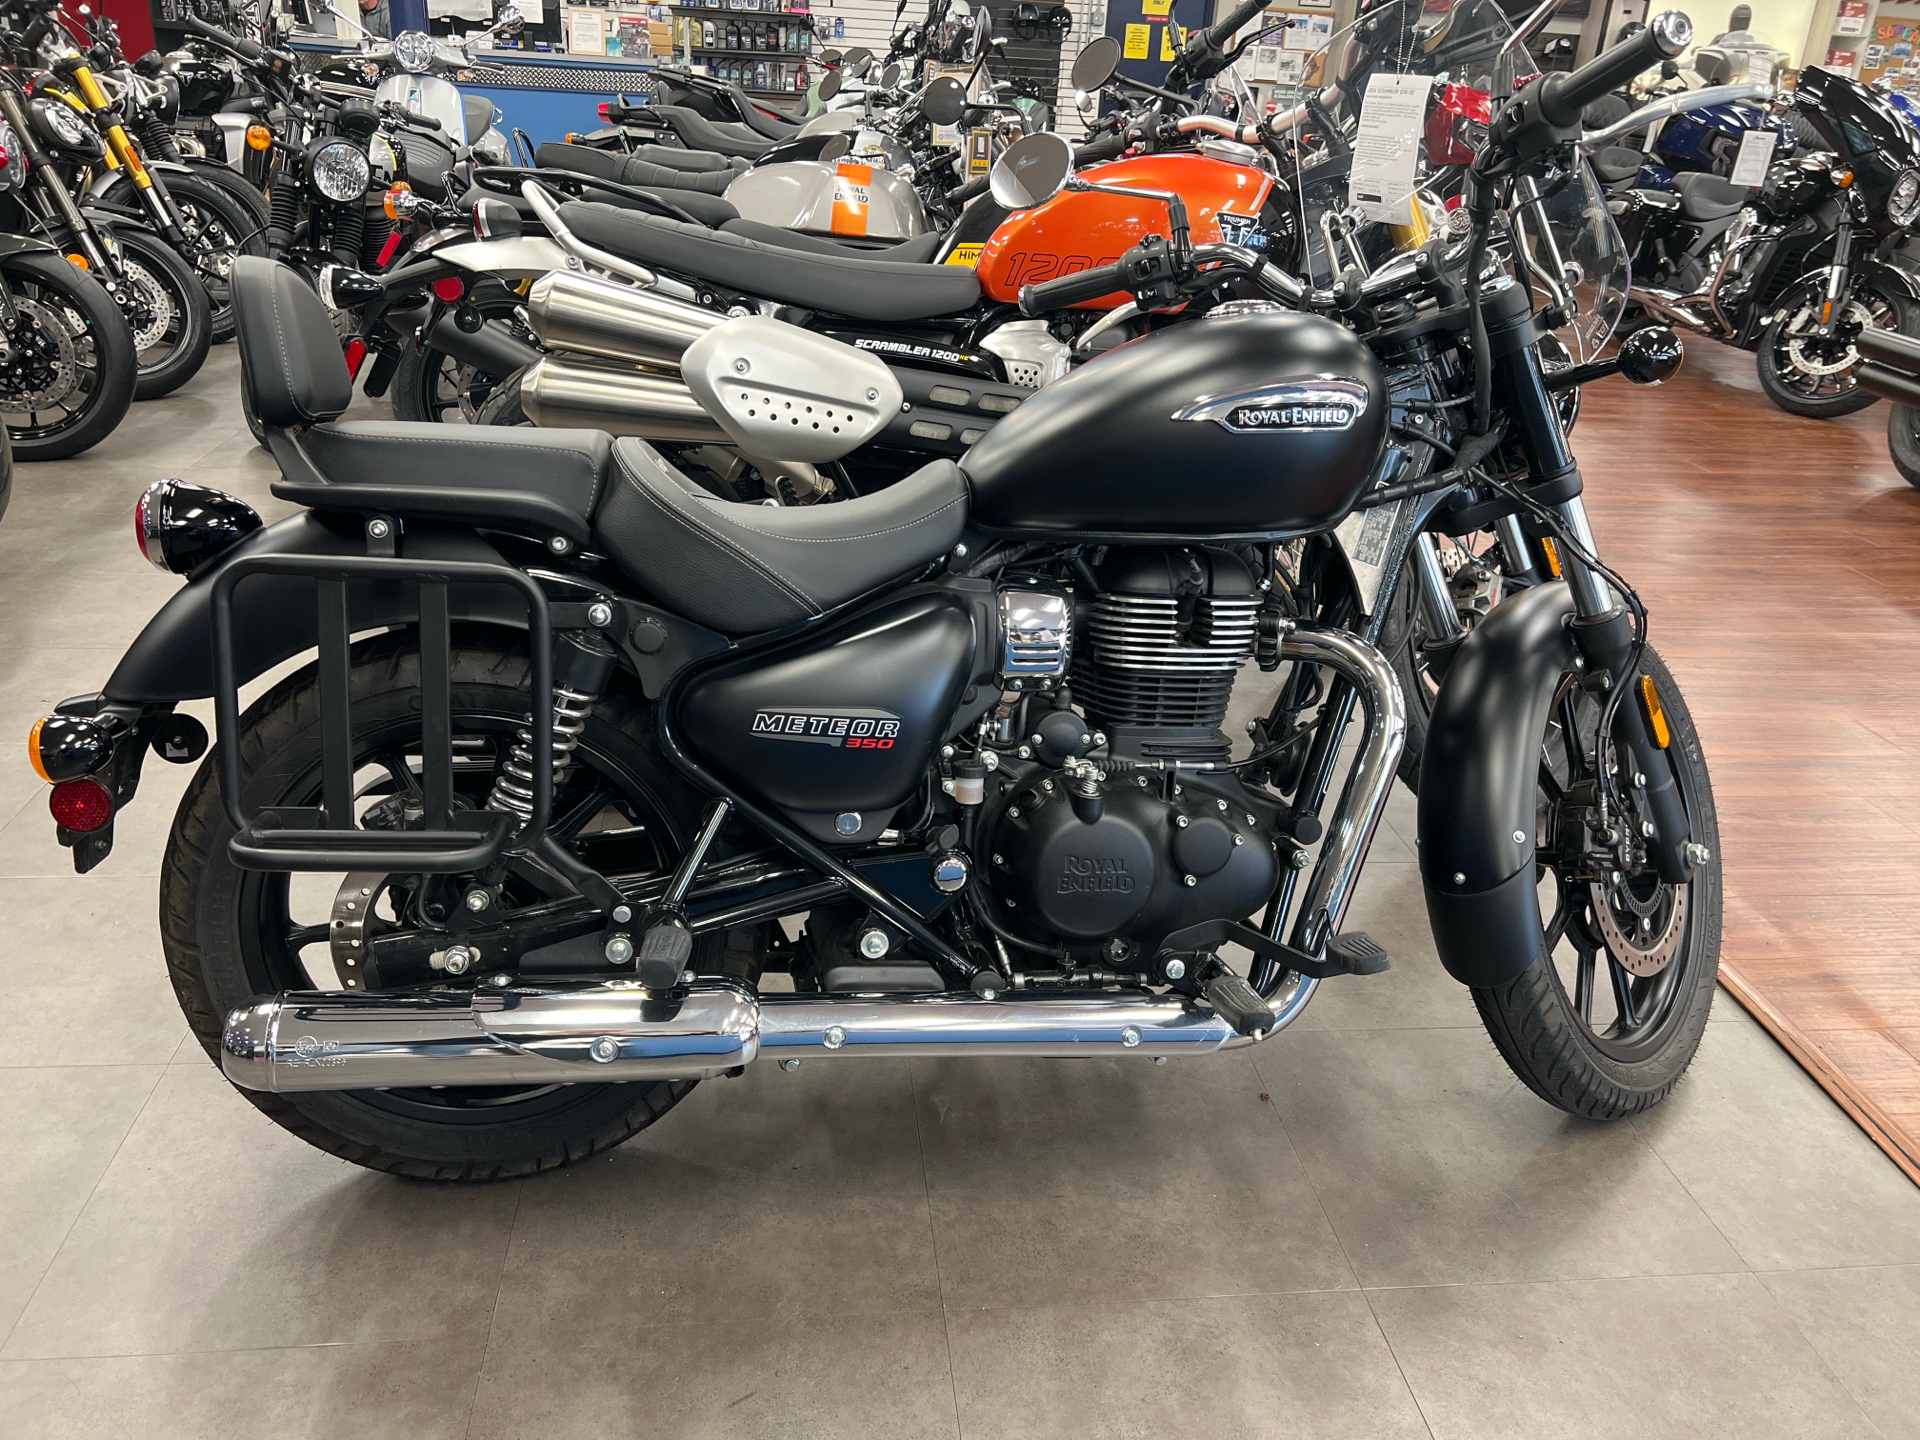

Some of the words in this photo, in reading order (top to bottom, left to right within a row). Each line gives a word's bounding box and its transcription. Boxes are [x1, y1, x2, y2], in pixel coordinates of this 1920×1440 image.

[837, 185, 866, 194] RYAL
[834, 193, 869, 204] ENIELD
[1223, 215, 1251, 225] TRIUMPH
[958, 250, 981, 260] HIM
[853, 338, 931, 357] SCRAMBLER
[931, 349, 960, 362] 1200
[1238, 409, 1291, 426] ROYAL
[1291, 407, 1350, 426] ENFIELD
[752, 713, 901, 738] METEOR
[845, 738, 895, 750] 350
[1063, 854, 1129, 876] ROYAL
[1056, 875, 1136, 894] ENFIELD
